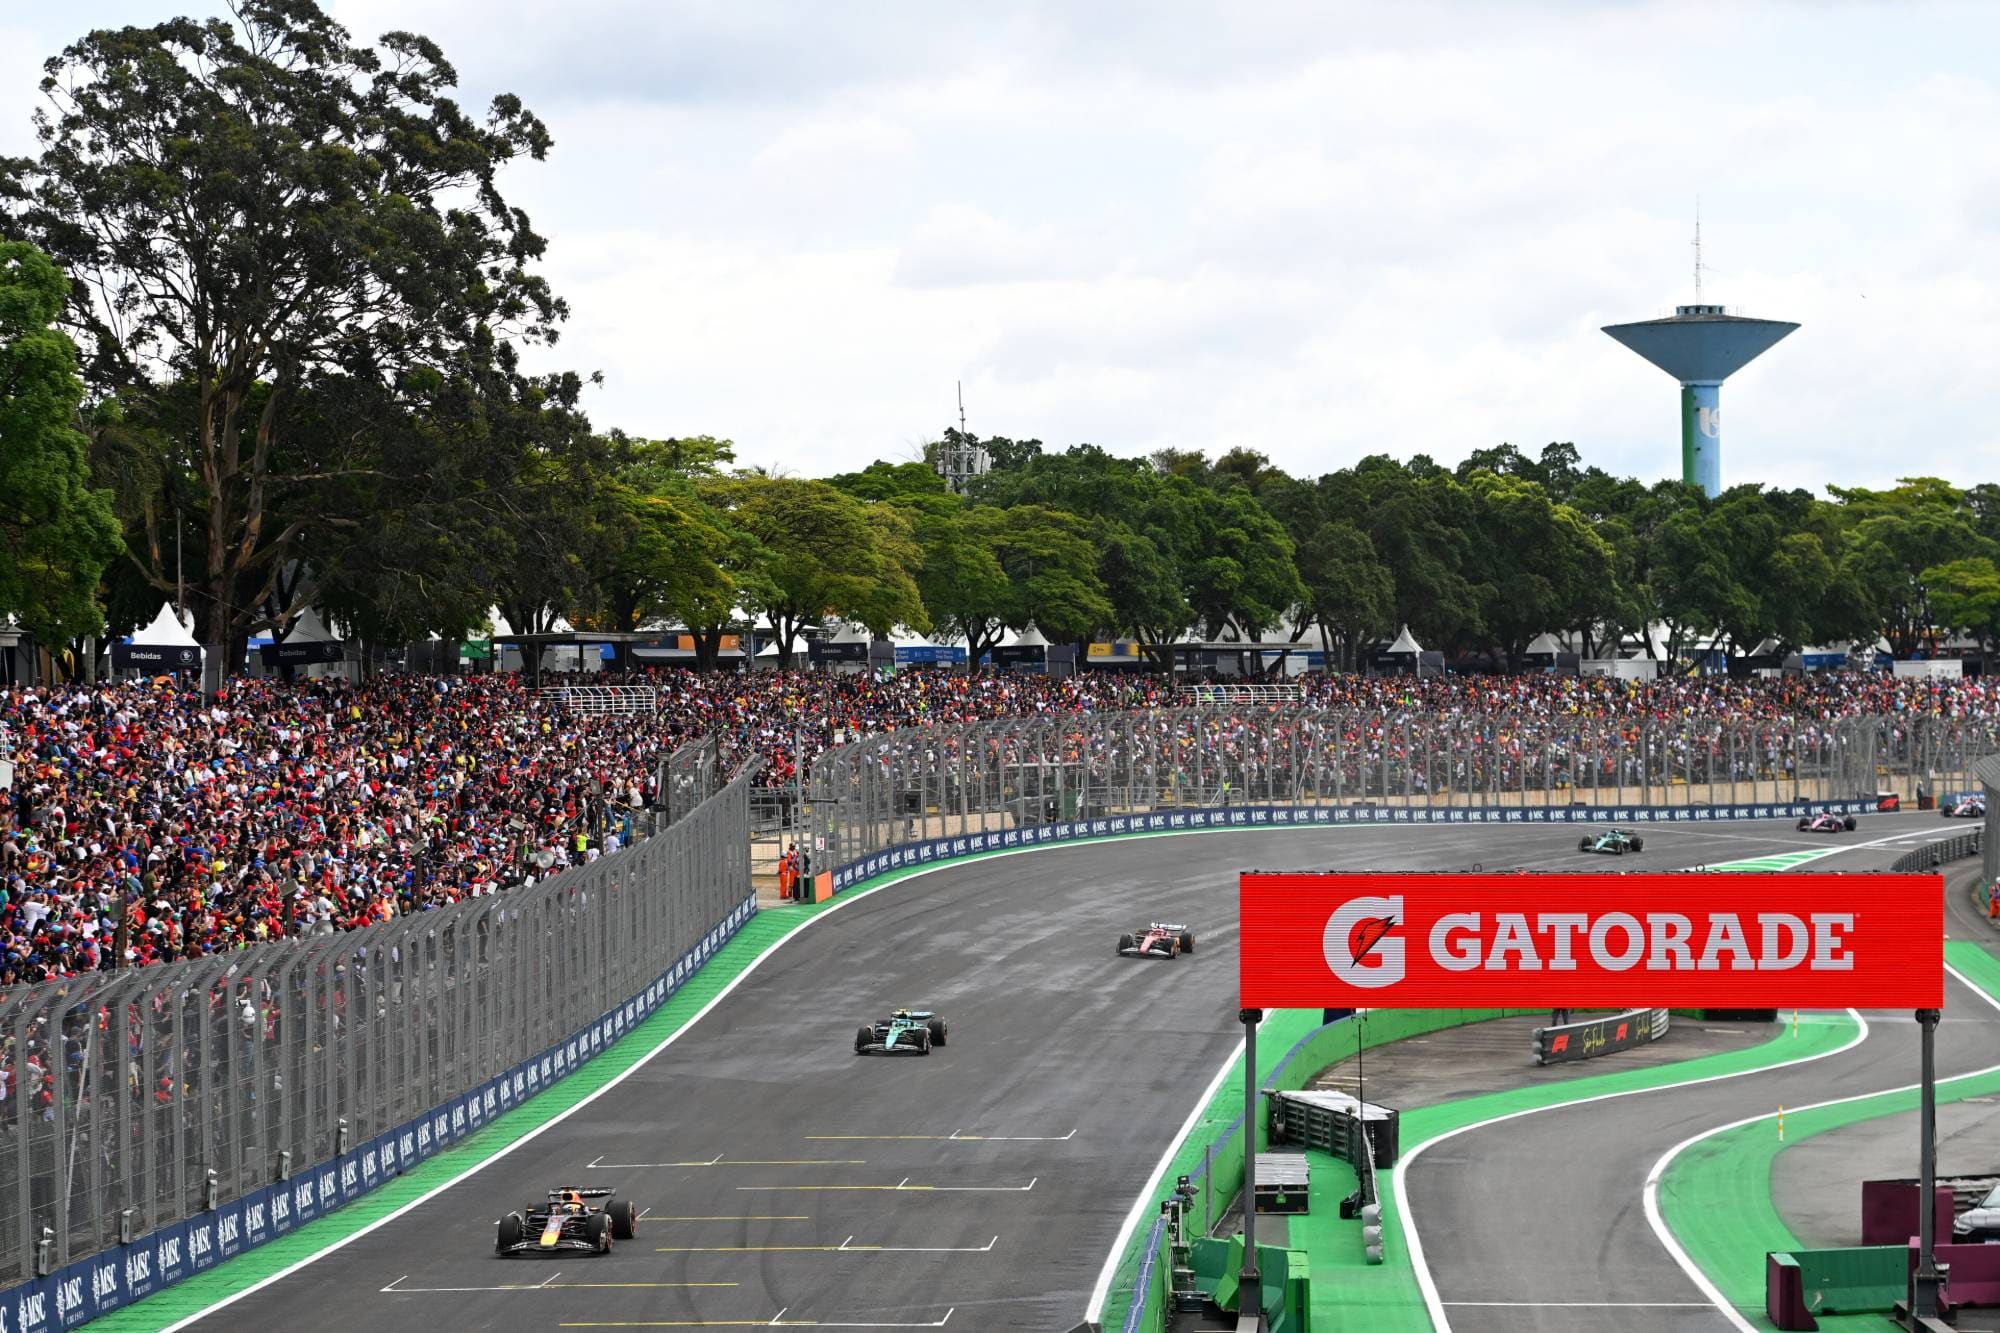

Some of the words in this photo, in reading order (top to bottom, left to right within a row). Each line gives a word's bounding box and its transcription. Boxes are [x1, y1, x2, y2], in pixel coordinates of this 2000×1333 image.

[130, 652, 162, 660] Bebidas
[1323, 895, 1405, 988] G
[1428, 912, 1854, 971] GATORADE
[300, 1181, 314, 1208] MSC
[324, 1171, 336, 1198] MSC
[251, 1202, 265, 1231] MSC
[276, 1192, 289, 1220] MSC
[195, 1225, 211, 1255] MSC
[224, 1213, 238, 1243] MSC
[133, 1250, 151, 1282] MSC
[165, 1236, 180, 1268] MSC
[64, 1277, 83, 1310] MSC
[99, 1263, 117, 1296] MSC
[27, 1292, 46, 1326] MSC
